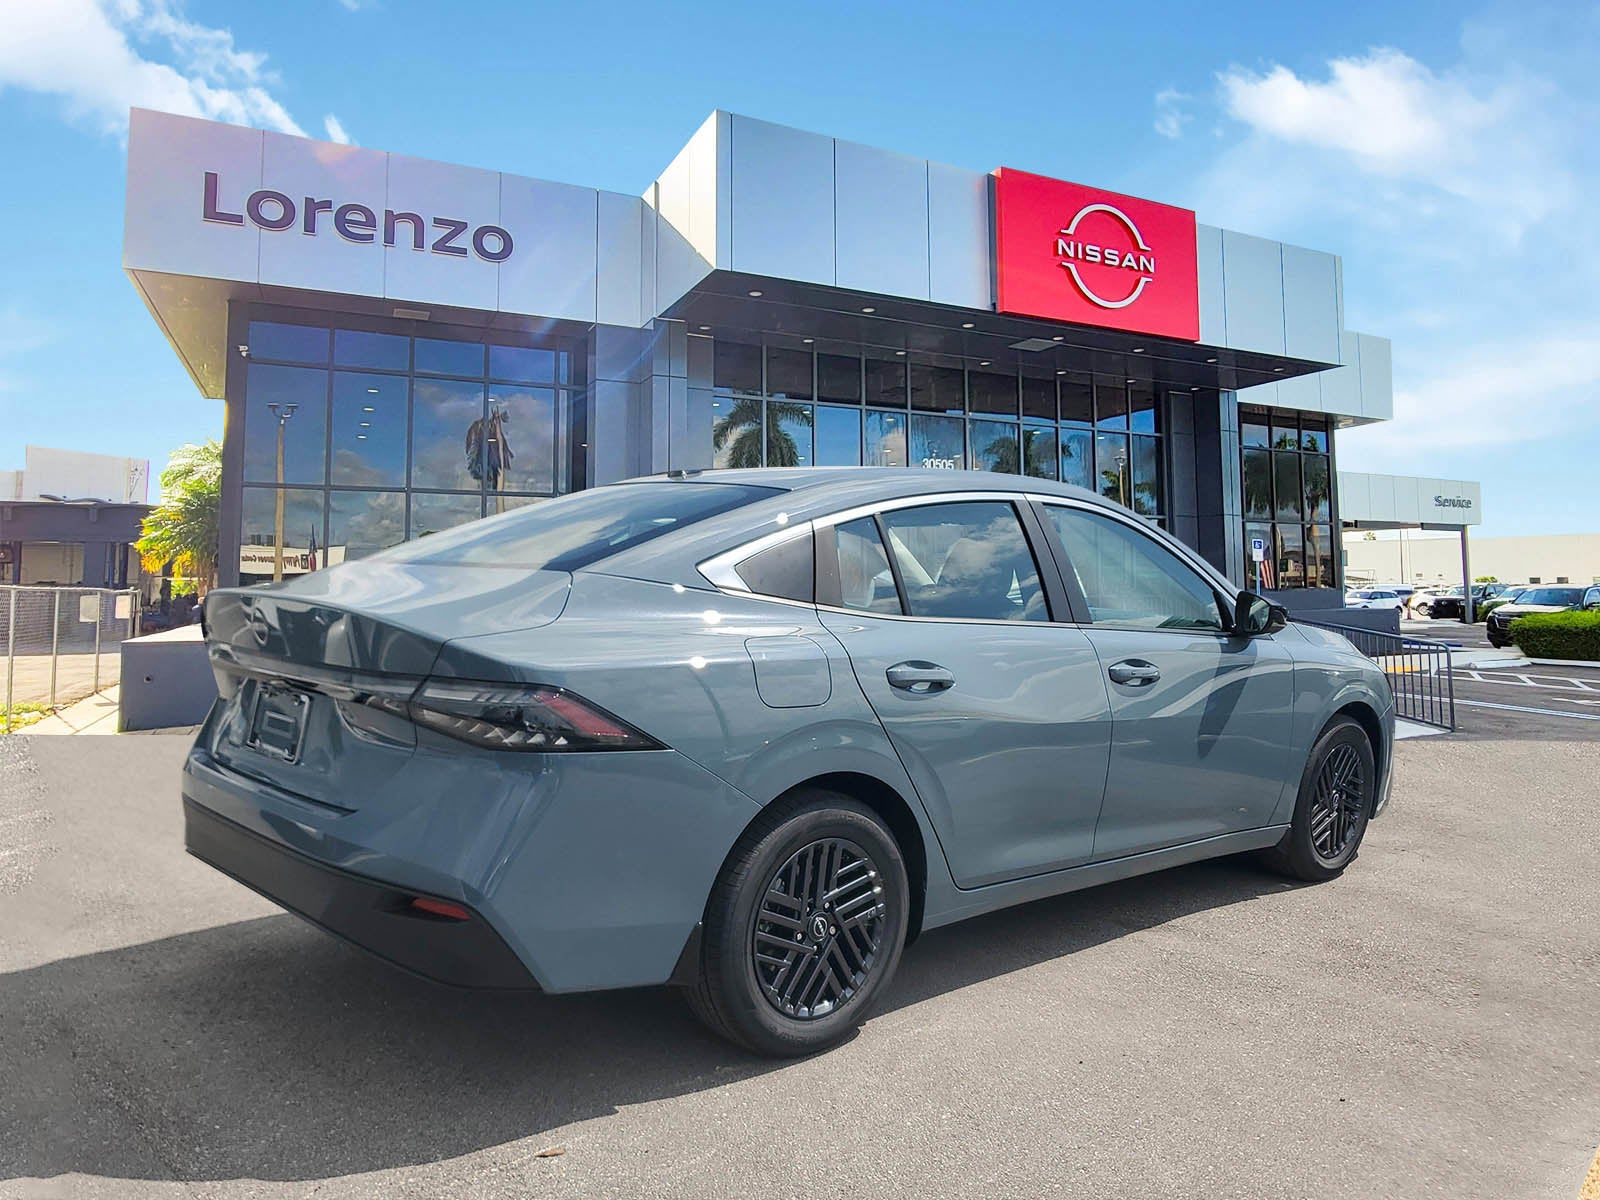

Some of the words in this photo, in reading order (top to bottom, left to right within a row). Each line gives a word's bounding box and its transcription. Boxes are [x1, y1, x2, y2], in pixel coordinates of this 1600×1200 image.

[203, 171, 514, 263] Lorenzo
[1057, 238, 1155, 273] NISSAN
[922, 457, 954, 470] 30505
[1434, 495, 1472, 509] Service
